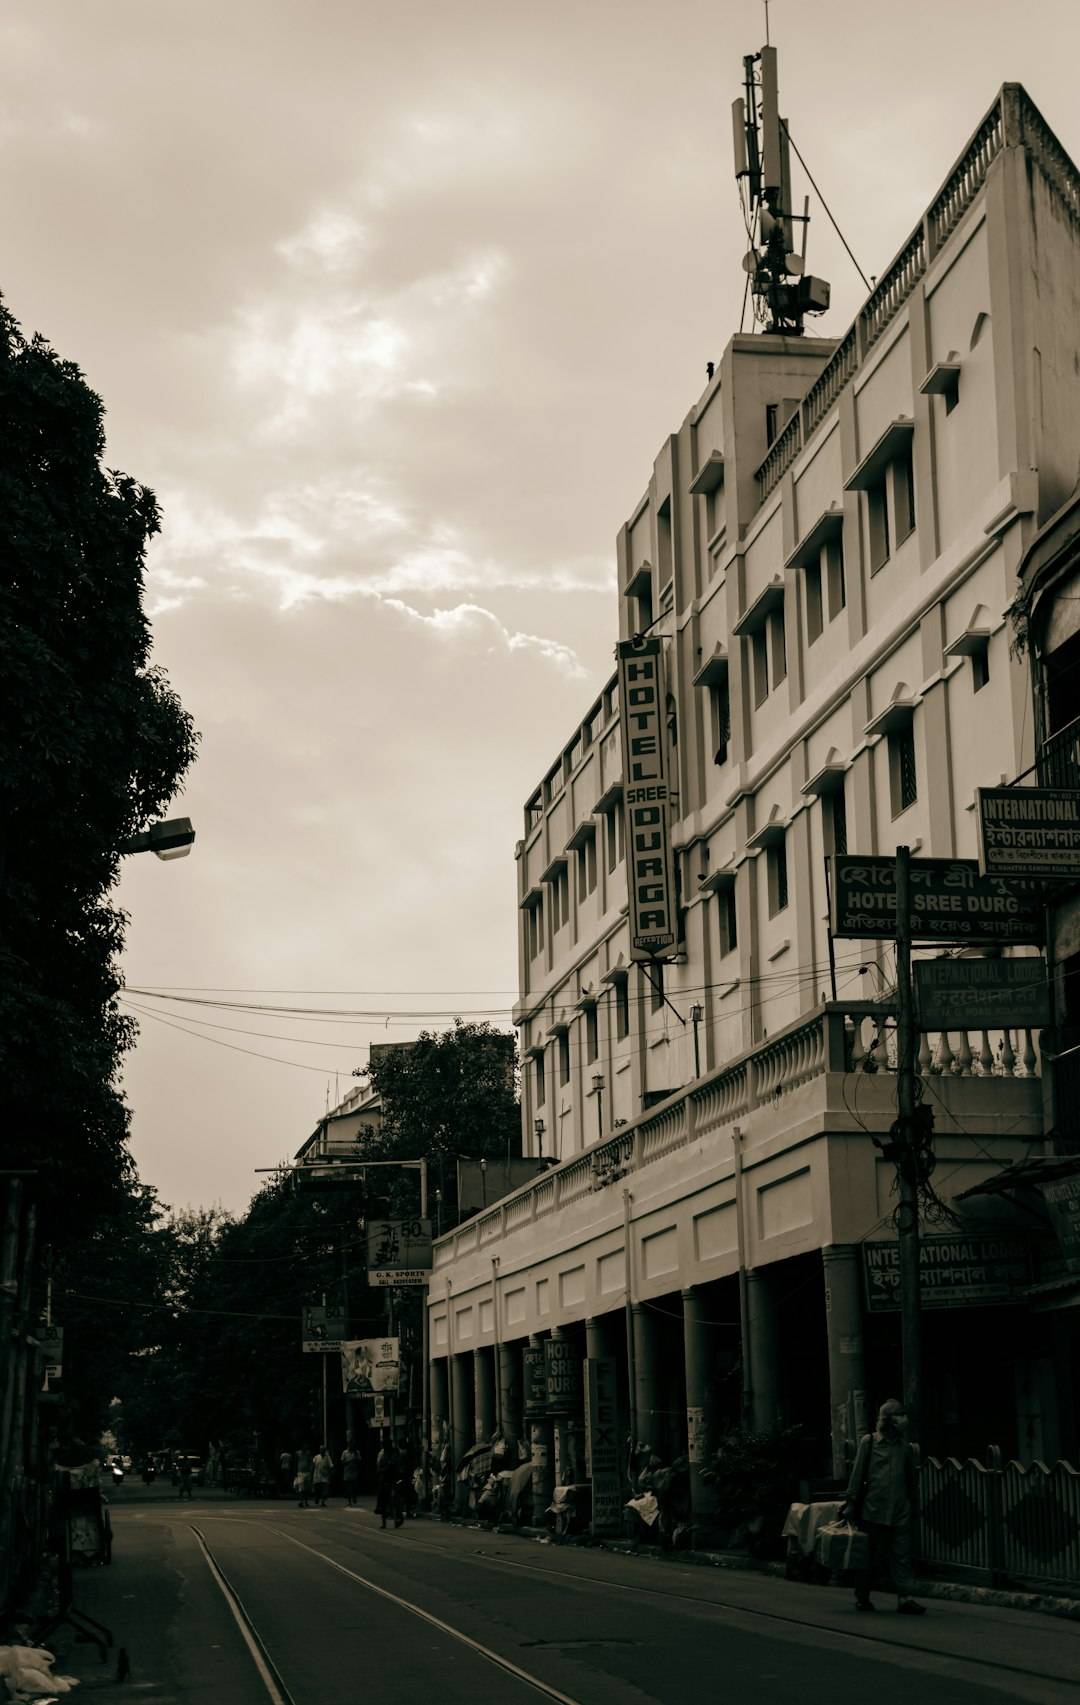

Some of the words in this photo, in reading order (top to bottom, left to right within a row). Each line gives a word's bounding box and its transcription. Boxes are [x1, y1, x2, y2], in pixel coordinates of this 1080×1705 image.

[627, 661, 657, 782] HOTEL
[626, 785, 668, 804] SREE
[983, 798, 1079, 821] INTERNATIONAL
[634, 806, 667, 931] DURGA
[847, 891, 897, 909] HOTE
[914, 893, 963, 912] SREE
[867, 1244, 979, 1267] INTEATIONAL
[594, 1362, 617, 1446] FLEX
